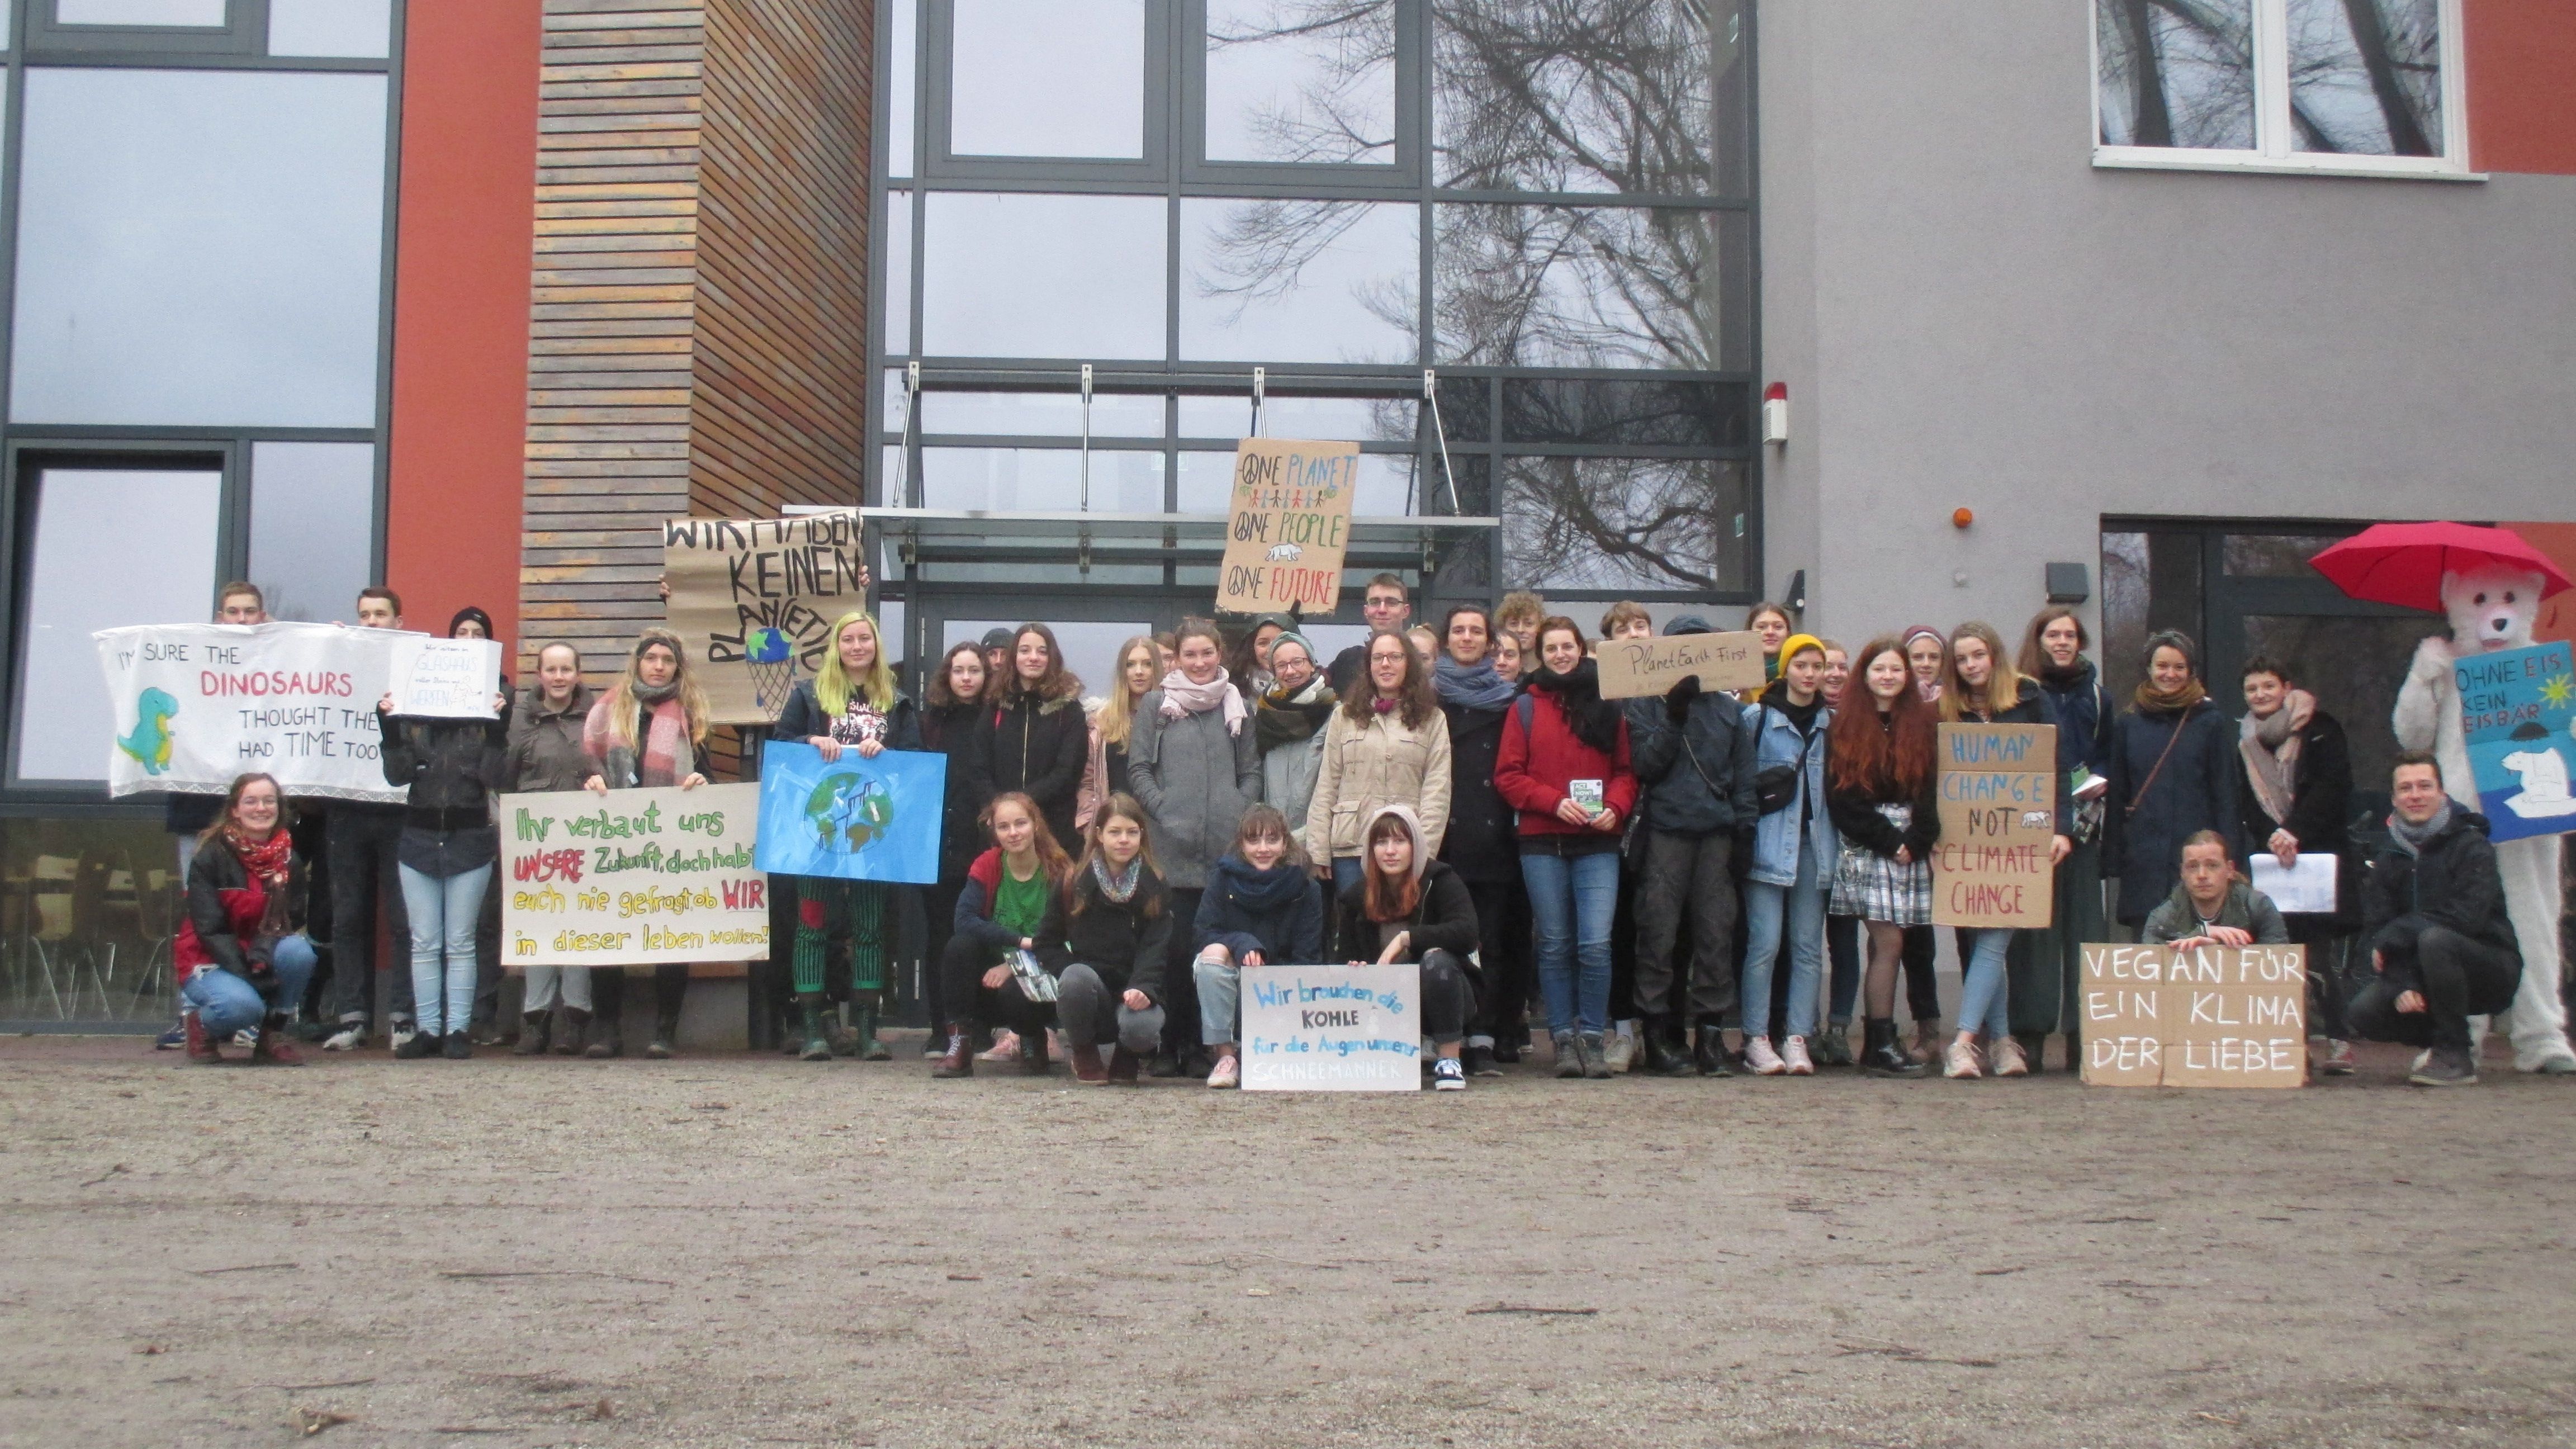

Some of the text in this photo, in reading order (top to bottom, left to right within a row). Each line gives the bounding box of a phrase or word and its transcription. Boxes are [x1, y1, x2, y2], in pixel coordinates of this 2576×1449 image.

[1242, 453, 1356, 489] ONE PLANET
[1234, 512, 1343, 547] ONE PEOPLE
[729, 546, 860, 603] KEINEN
[1228, 565, 1335, 605] ONE FUTURE
[144, 643, 189, 661] SURE
[205, 646, 241, 664] THE
[1621, 645, 1748, 675] Planet Earth First
[201, 670, 353, 698] DINOSAURS
[2455, 653, 2562, 692] OHNE EIS
[2460, 690, 2507, 712] KEIN
[239, 706, 331, 728] THOUGHT
[2463, 703, 2540, 733] EISBÄR
[239, 731, 379, 760] HAD TIME TOO
[1951, 733, 2035, 764] HUMAN
[1943, 771, 2045, 802] CHANGE
[517, 801, 724, 842] Ihr verbaut uns
[1968, 807, 2018, 836] NOT
[514, 848, 585, 883] UNSERE
[666, 850, 711, 874] doch
[1942, 842, 2039, 873] CLIMATE
[513, 883, 565, 913] euch
[577, 887, 610, 912] nie
[693, 887, 718, 909] ob
[721, 879, 765, 910] WIR
[1951, 881, 2025, 915] CHANGE
[515, 924, 769, 955] in dieser leben wollen!
[2085, 946, 2305, 984] VEGAN FÜR
[1253, 978, 1404, 1015] Wir brauchen die
[2088, 991, 2303, 1029] EIN KLIMA
[1301, 1010, 1359, 1030] KOHLE
[1284, 1035, 1310, 1052] die
[1318, 1034, 1365, 1057] Augen
[2092, 1036, 2295, 1073] DER LIEBE
